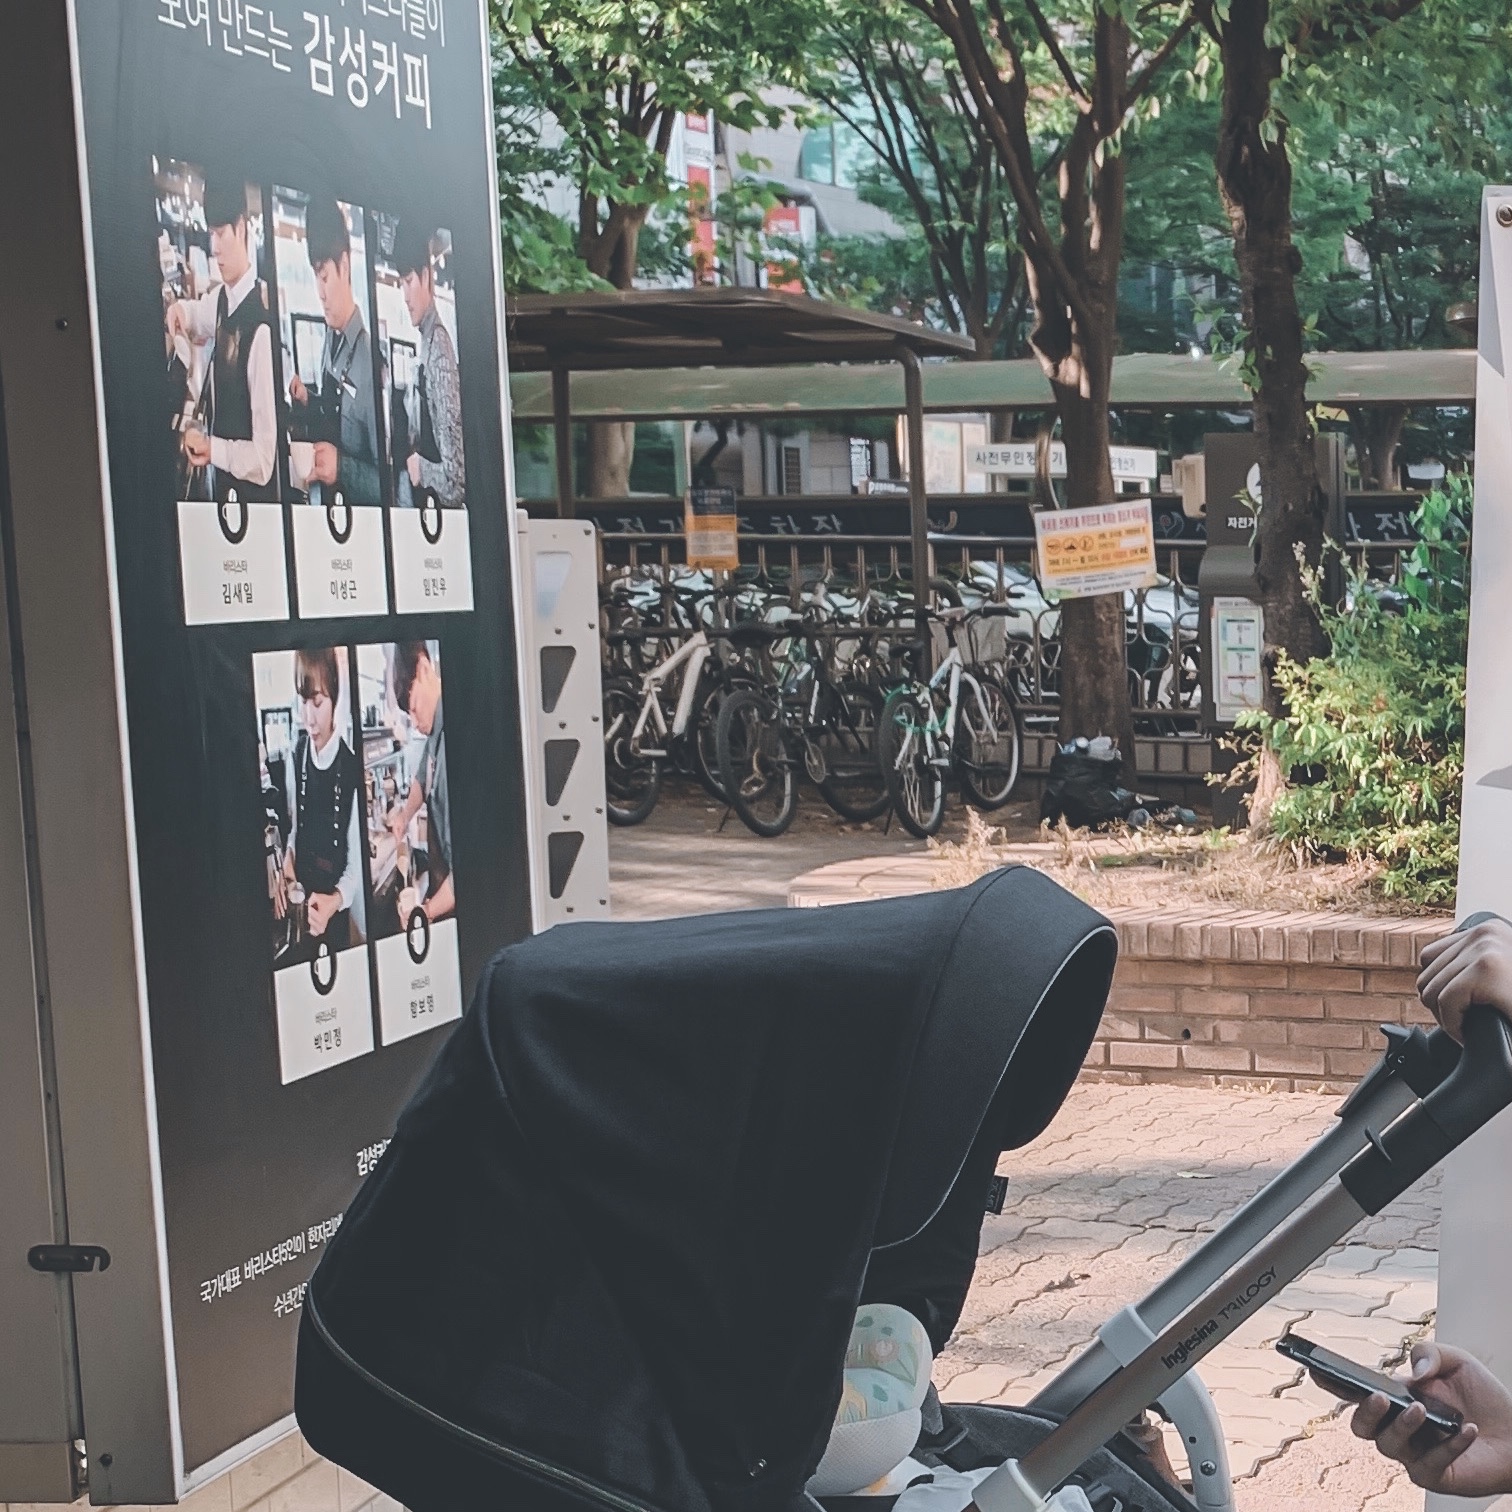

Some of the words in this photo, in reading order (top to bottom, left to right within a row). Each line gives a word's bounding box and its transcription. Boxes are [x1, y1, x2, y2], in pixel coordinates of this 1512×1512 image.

[303, 11, 432, 130] 감성커피
[200, 1266, 243, 1304] 국가대표
[1160, 1319, 1219, 1370] Inglesina
[1217, 1265, 1277, 1320] TRILOGY
